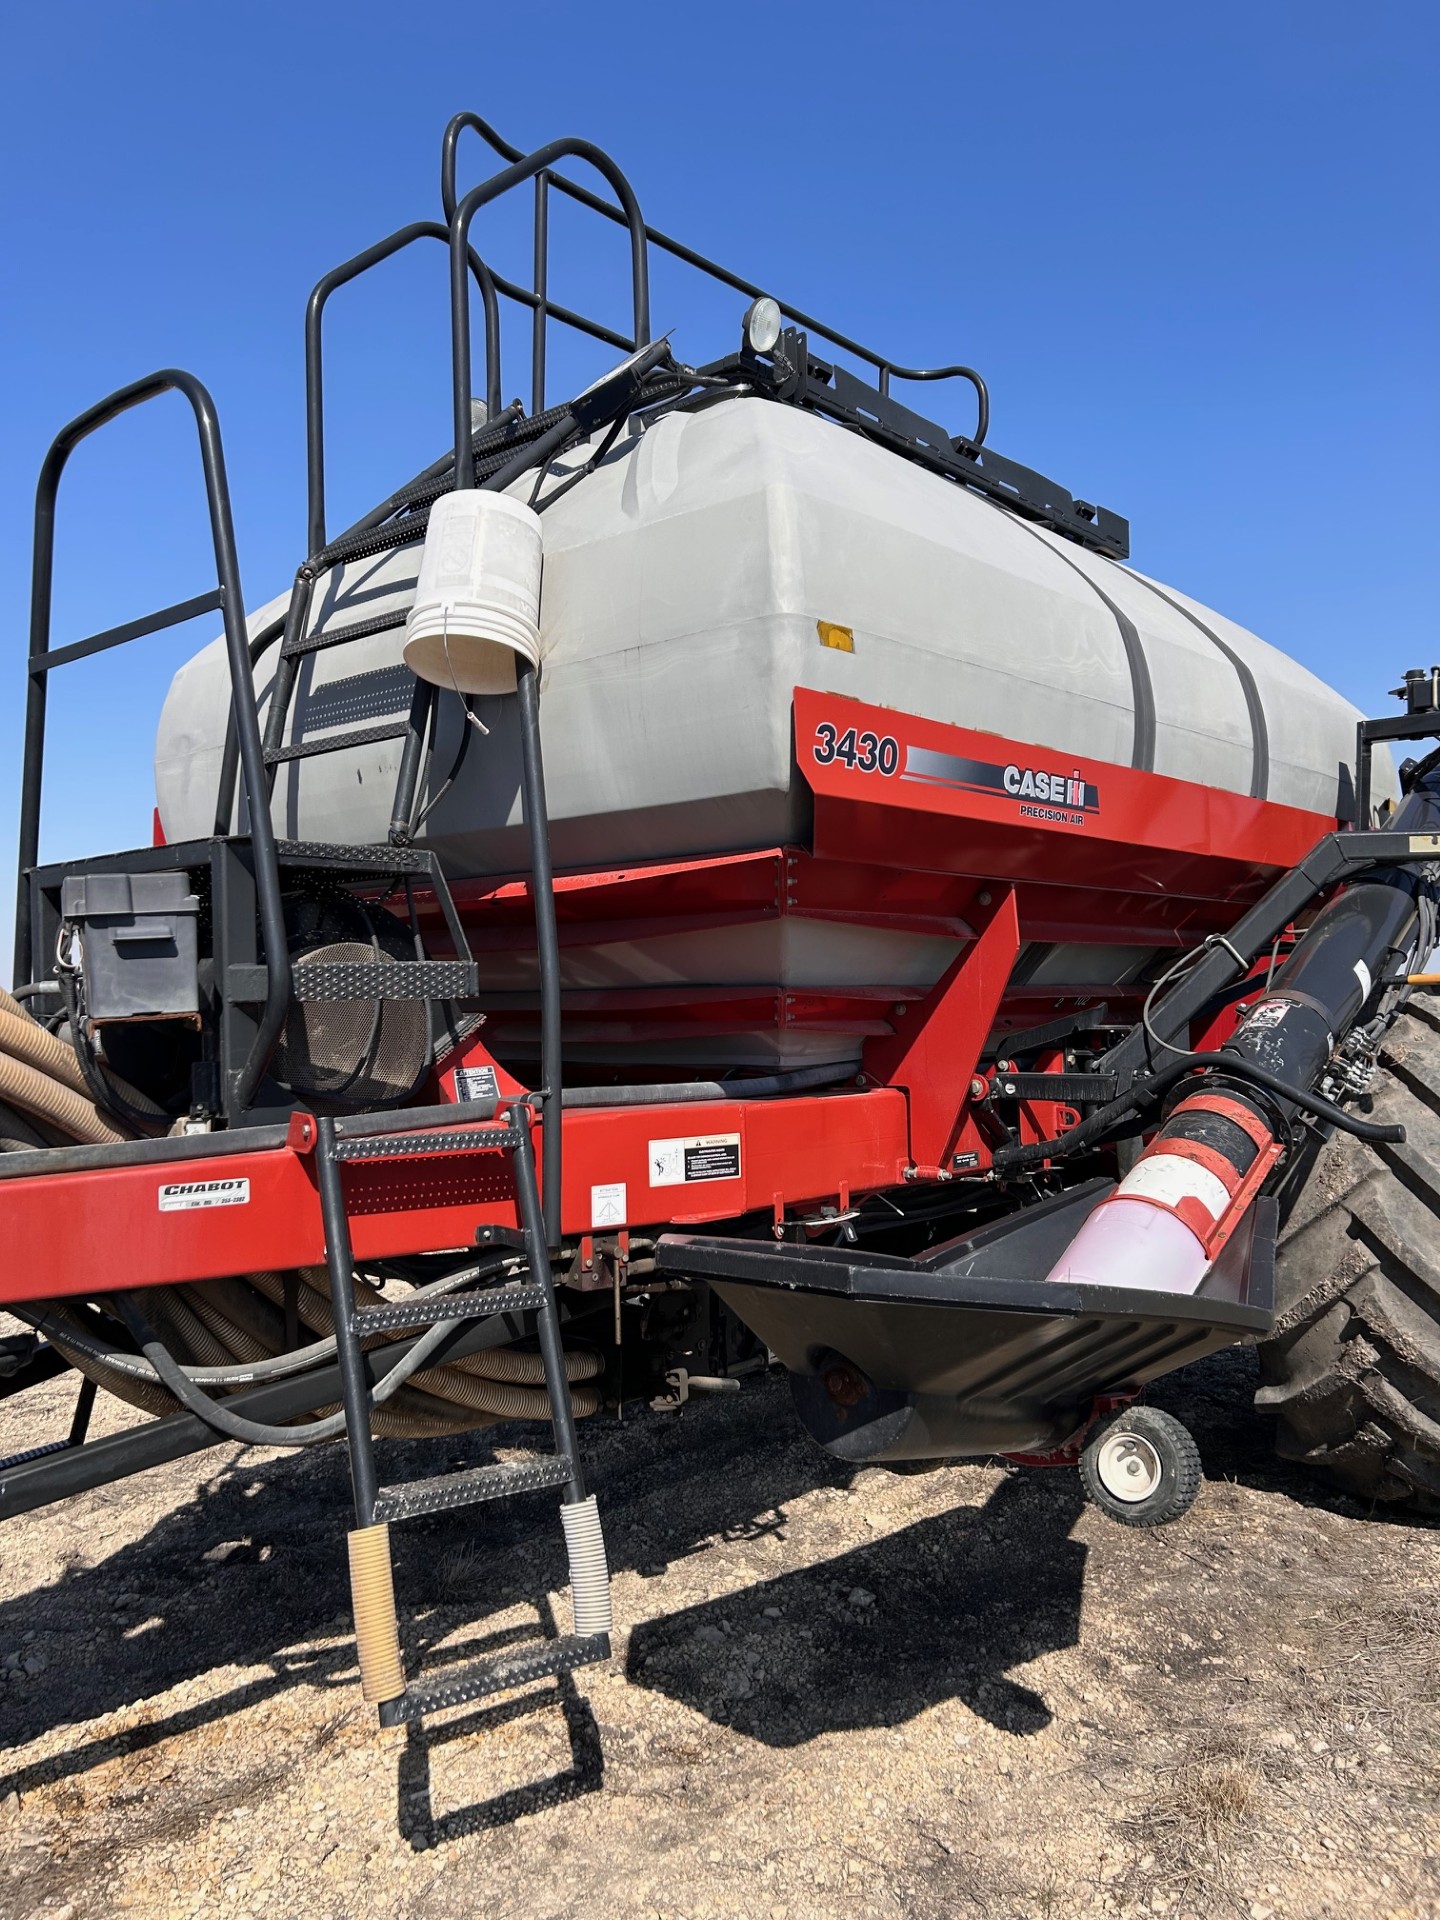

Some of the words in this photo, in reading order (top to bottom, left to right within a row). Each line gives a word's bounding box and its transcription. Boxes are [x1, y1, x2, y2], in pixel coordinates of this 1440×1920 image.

[813, 722, 899, 777] 3430
[1020, 804, 1068, 823] PRECISION
[1069, 813, 1084, 826] AIR
[164, 1180, 247, 1196] CHABOT
